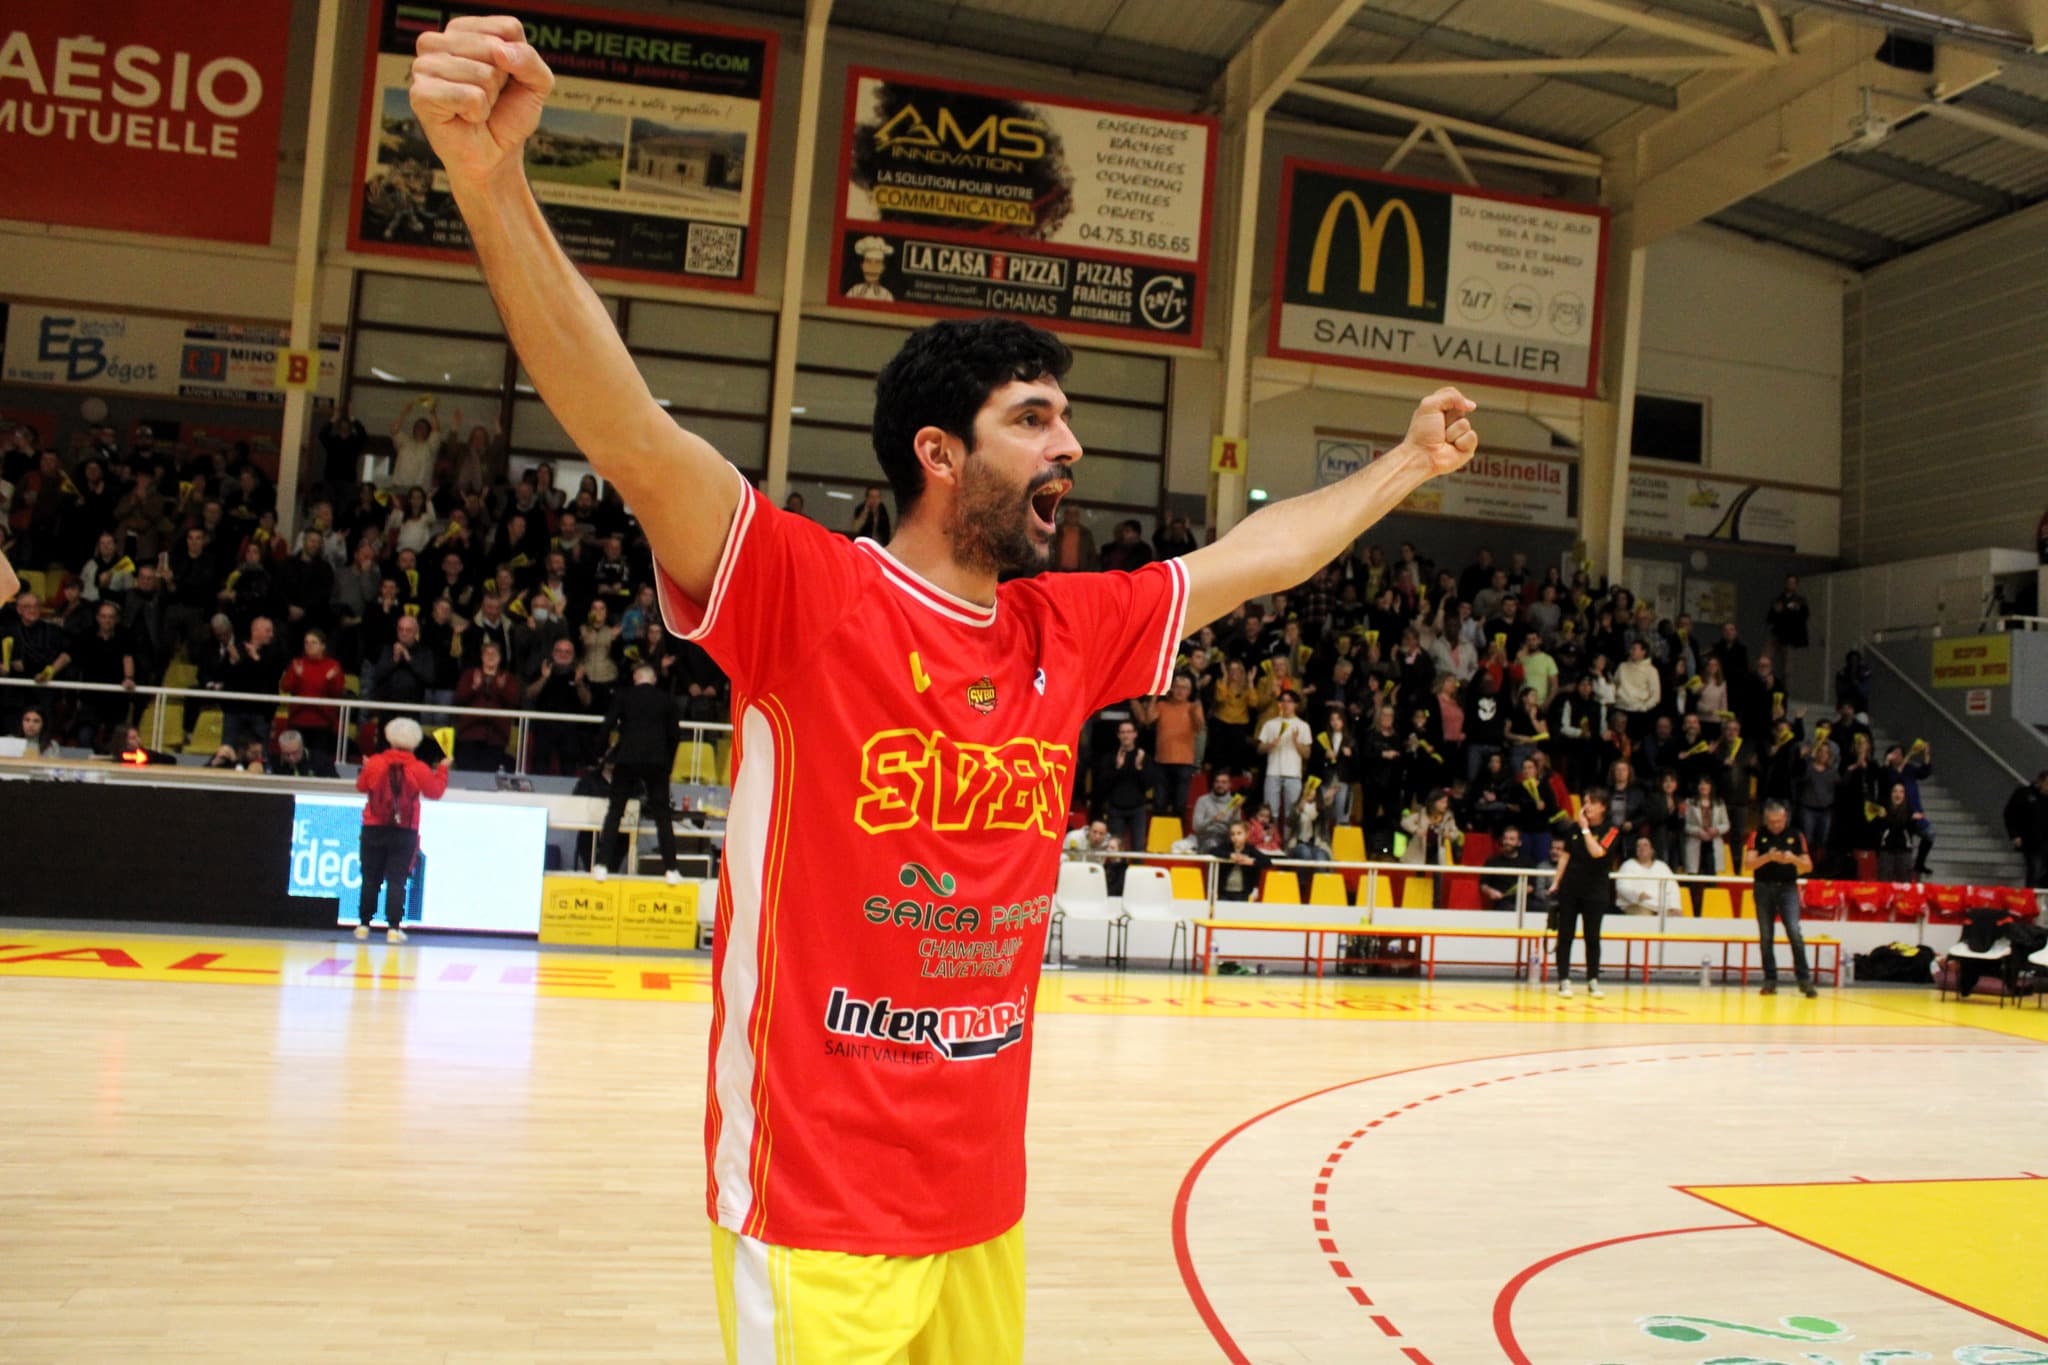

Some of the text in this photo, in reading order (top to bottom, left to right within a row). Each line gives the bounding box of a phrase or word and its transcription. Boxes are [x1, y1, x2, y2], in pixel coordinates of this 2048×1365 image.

[522, 22, 749, 72] ON-PIERRE.COM
[0, 31, 263, 118] AÉSIO
[874, 104, 1045, 159] AMS
[1097, 119, 1189, 141] ENSEIGNES
[892, 146, 1024, 173] INNOVATION
[877, 170, 1033, 200] LA SOLUTION POUR VOTRE
[1096, 169, 1183, 193] COVERING
[875, 188, 1033, 221] COMMUNICATION
[1105, 187, 1171, 208] TEXTILES
[1097, 204, 1155, 222] OBJETS
[1079, 223, 1190, 254] 04.75.31.65.65
[910, 246, 934, 271] LA
[938, 248, 986, 276] CASA
[1008, 258, 1061, 286] PIZZA
[1076, 261, 1134, 289] PIZZAS
[229, 349, 276, 363] MINO
[1314, 318, 1561, 374] SAINT VALLIER
[287, 354, 308, 384] B
[1218, 442, 1238, 469] A
[1456, 454, 1560, 484] uisinella
[862, 895, 981, 934] SAICA
[825, 1039, 935, 1065] SAINT VALLIER
